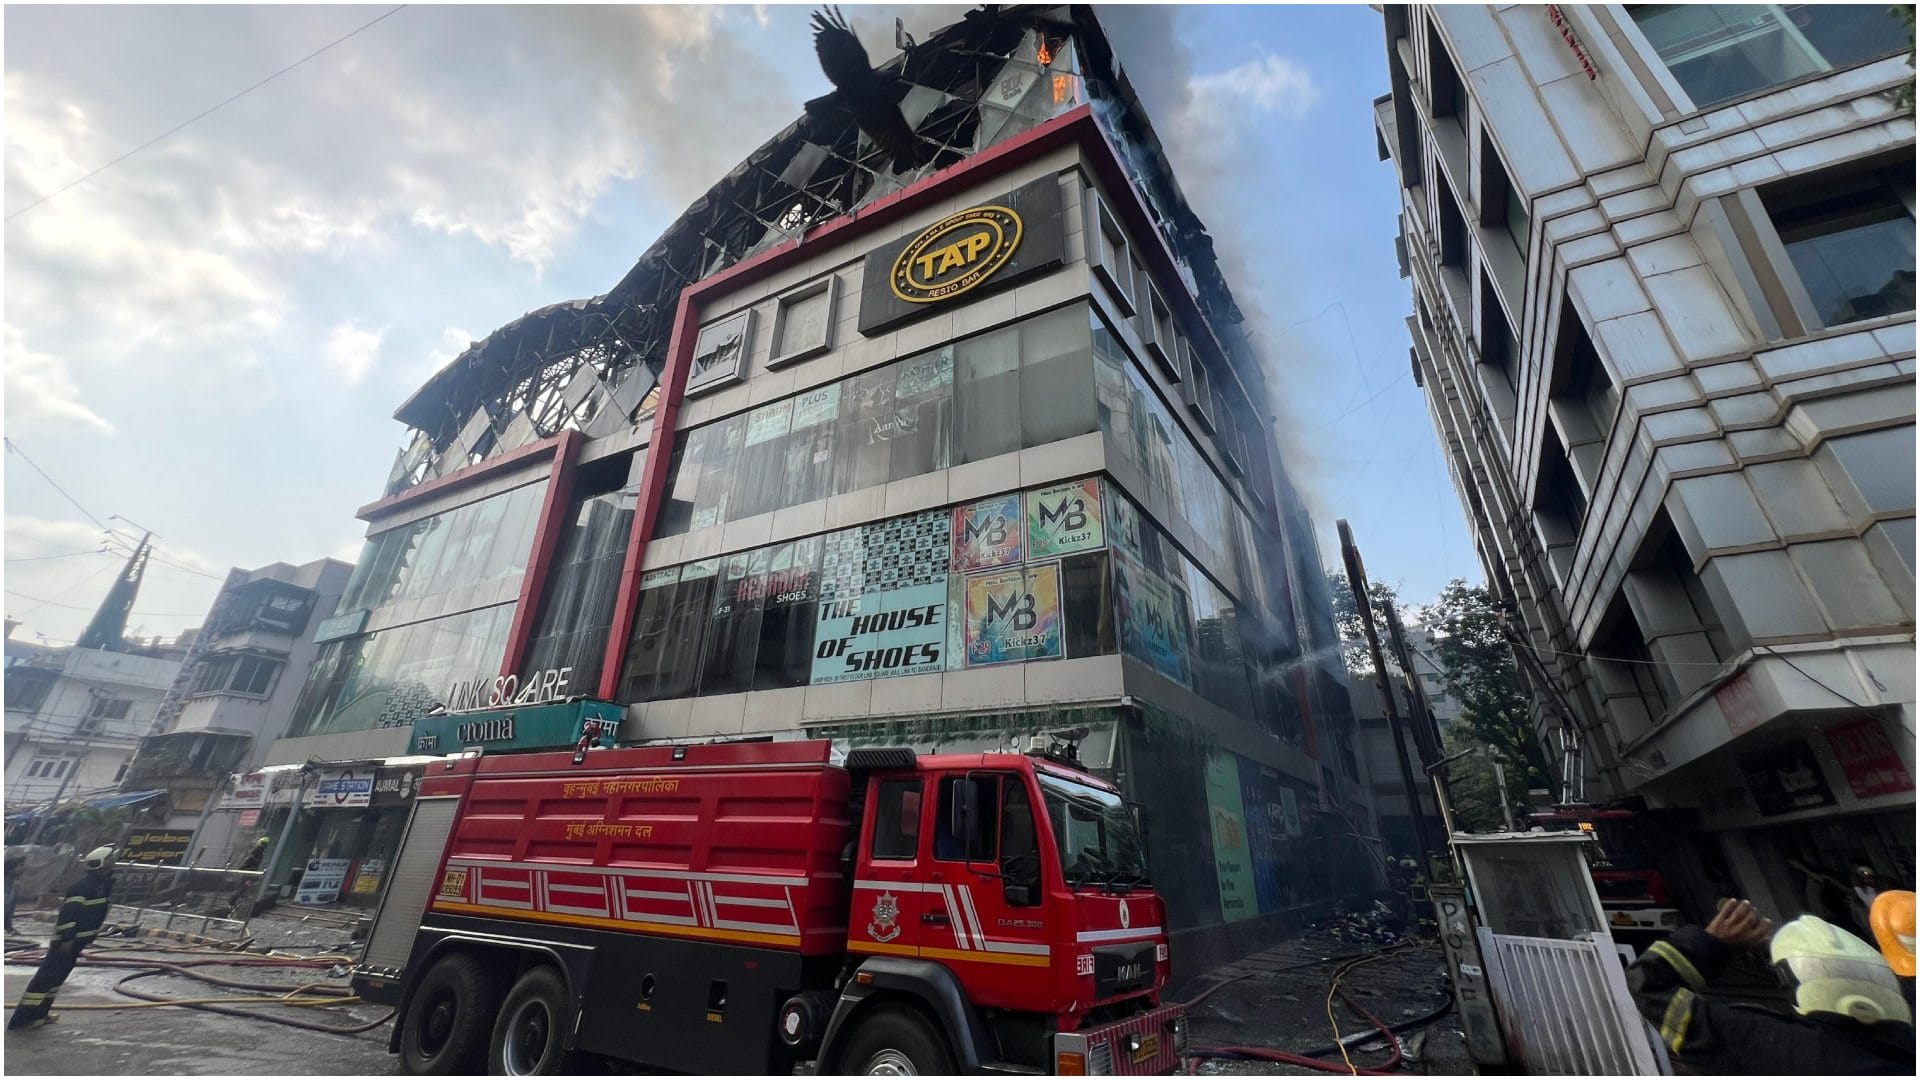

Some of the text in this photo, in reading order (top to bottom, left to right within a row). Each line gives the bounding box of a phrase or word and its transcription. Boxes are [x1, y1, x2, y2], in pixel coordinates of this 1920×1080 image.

[916, 231, 991, 280] TAP
[928, 271, 981, 298] RESTO BAR
[802, 391, 829, 407] PLUS
[1038, 495, 1088, 532] MB
[1058, 532, 1092, 545] Kickz37
[776, 590, 807, 604] SHOES
[821, 600, 858, 621] THE
[850, 603, 945, 636] HOUSE
[987, 588, 1037, 631] MB
[816, 636, 857, 659] OF
[1004, 634, 1047, 648] Kickz37
[844, 641, 942, 674] SHOES
[339, 778, 371, 791] STATION
[634, 824, 653, 838] दल
